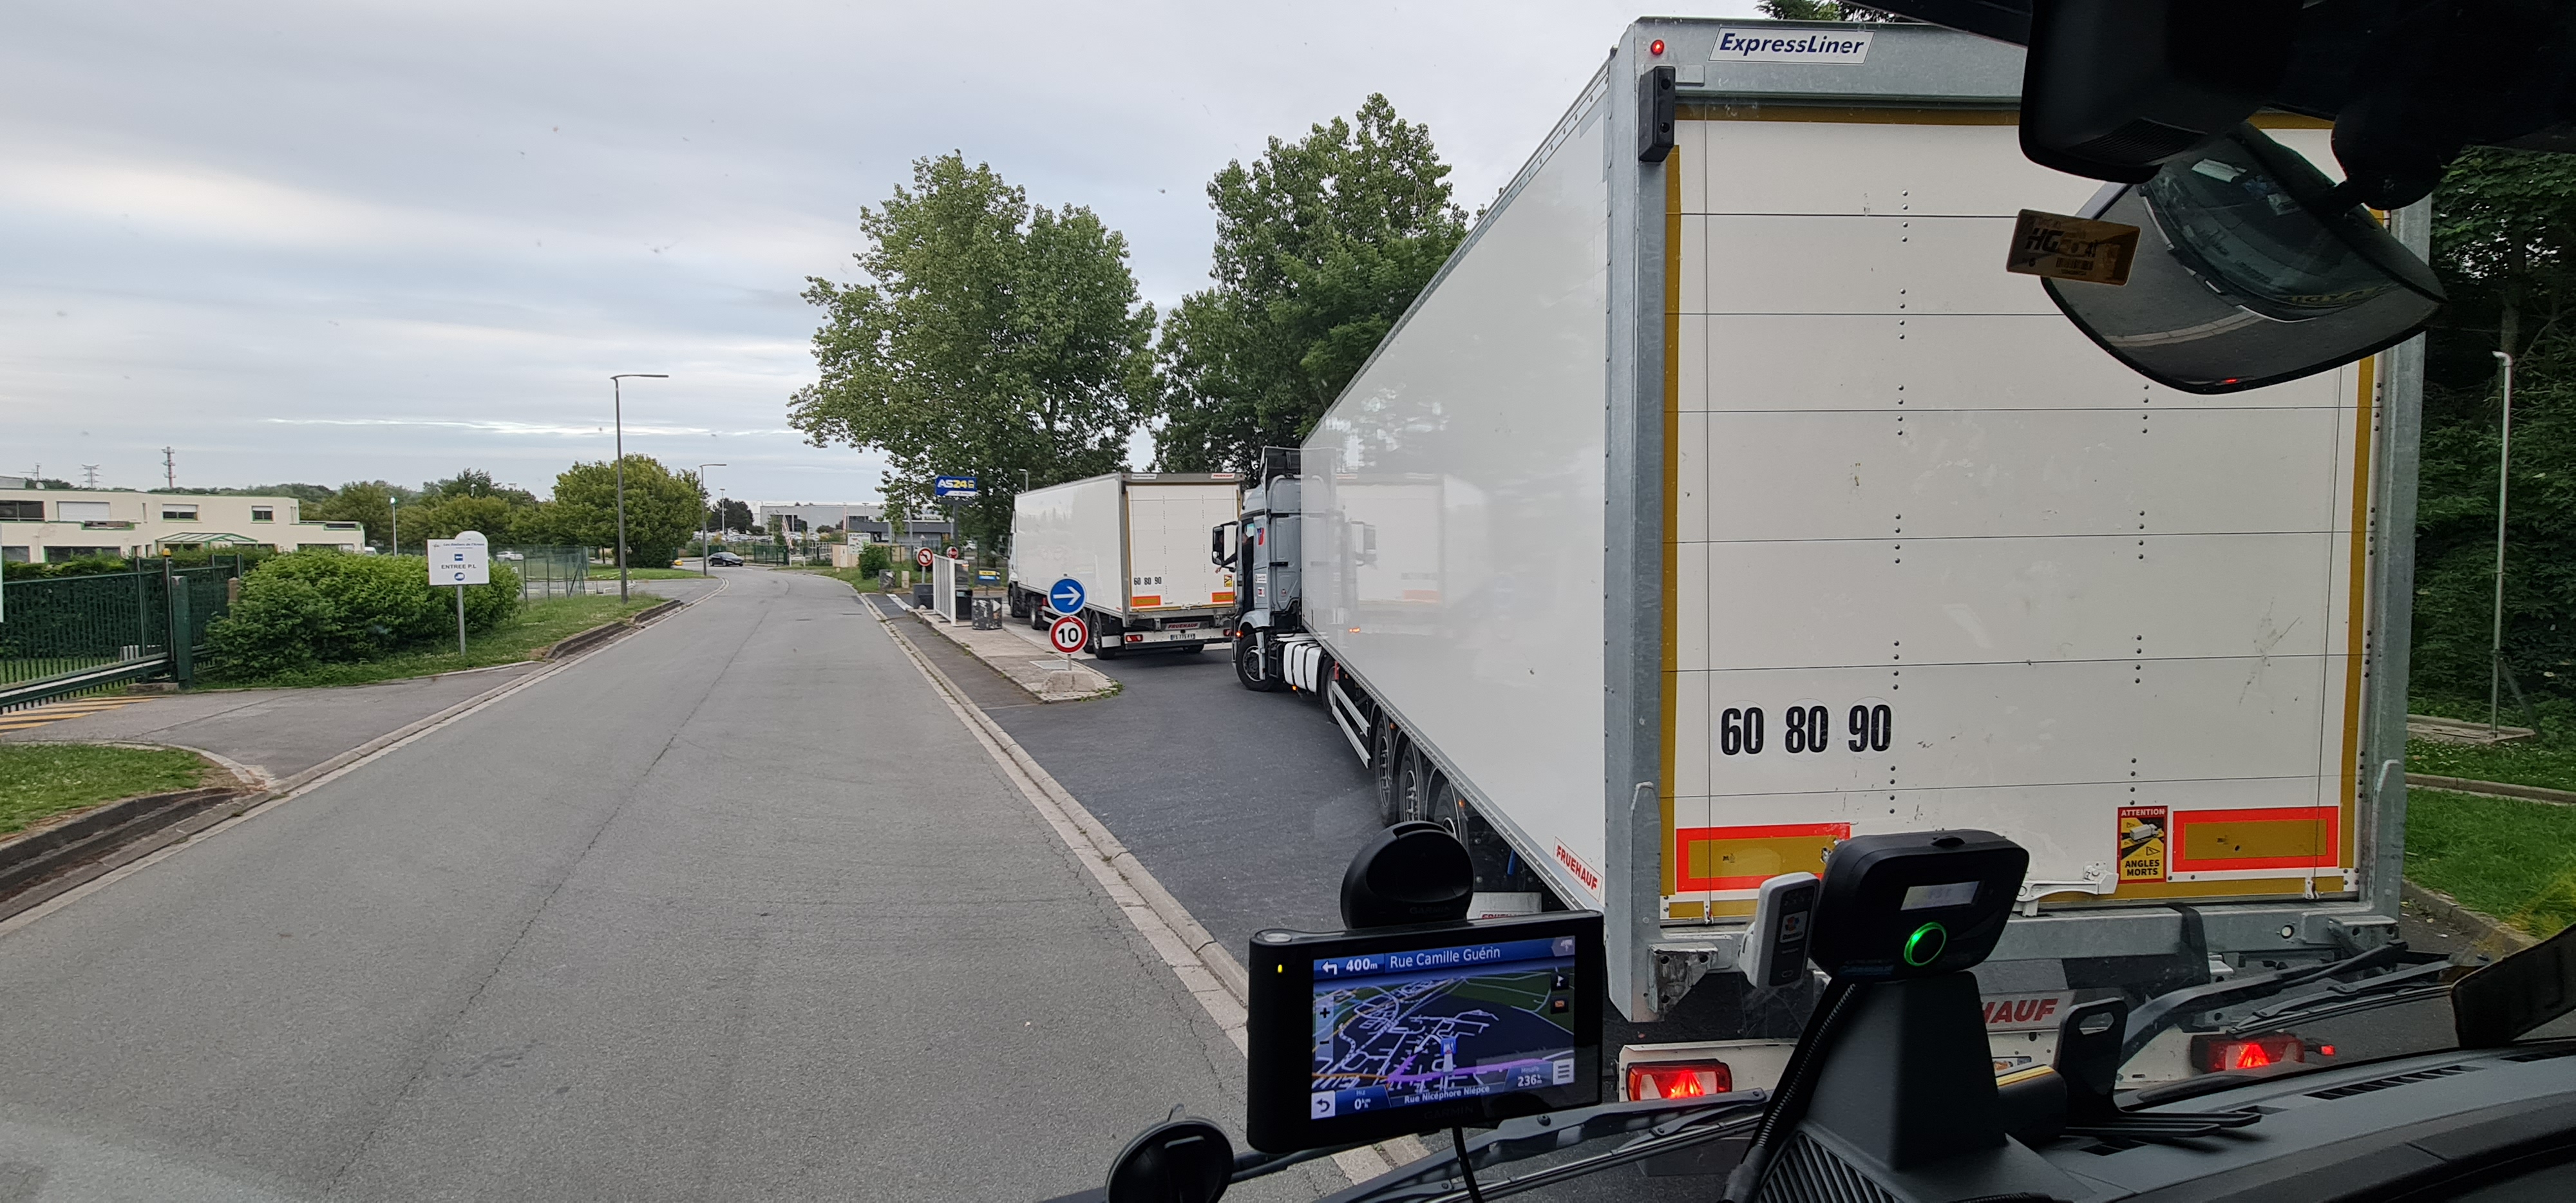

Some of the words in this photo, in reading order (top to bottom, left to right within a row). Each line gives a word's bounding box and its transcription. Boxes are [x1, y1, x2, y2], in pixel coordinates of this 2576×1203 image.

[1719, 33, 1864, 56] ExpressLiner
[937, 479, 967, 489] AS24
[1133, 577, 1141, 585] 60
[1144, 577, 1151, 585] 80
[1154, 576, 1162, 585] 90
[1058, 627, 1079, 643] 10
[1721, 707, 1764, 755] 60
[1785, 705, 1828, 753] 80
[1848, 705, 1891, 752] 90
[2121, 808, 2165, 817] ATTENTION
[1556, 844, 1598, 890] FRUEHAUF
[2125, 859, 2160, 868] ANGLES
[2126, 867, 2158, 876] MORTS
[1345, 958, 1378, 972] 400m
[1390, 956, 1413, 969] Rue
[1416, 950, 1459, 967] Camille
[1462, 946, 1501, 961] Guérin
[1405, 1095, 1420, 1104] Rue
[1422, 1089, 1462, 1101] Nicéphore
